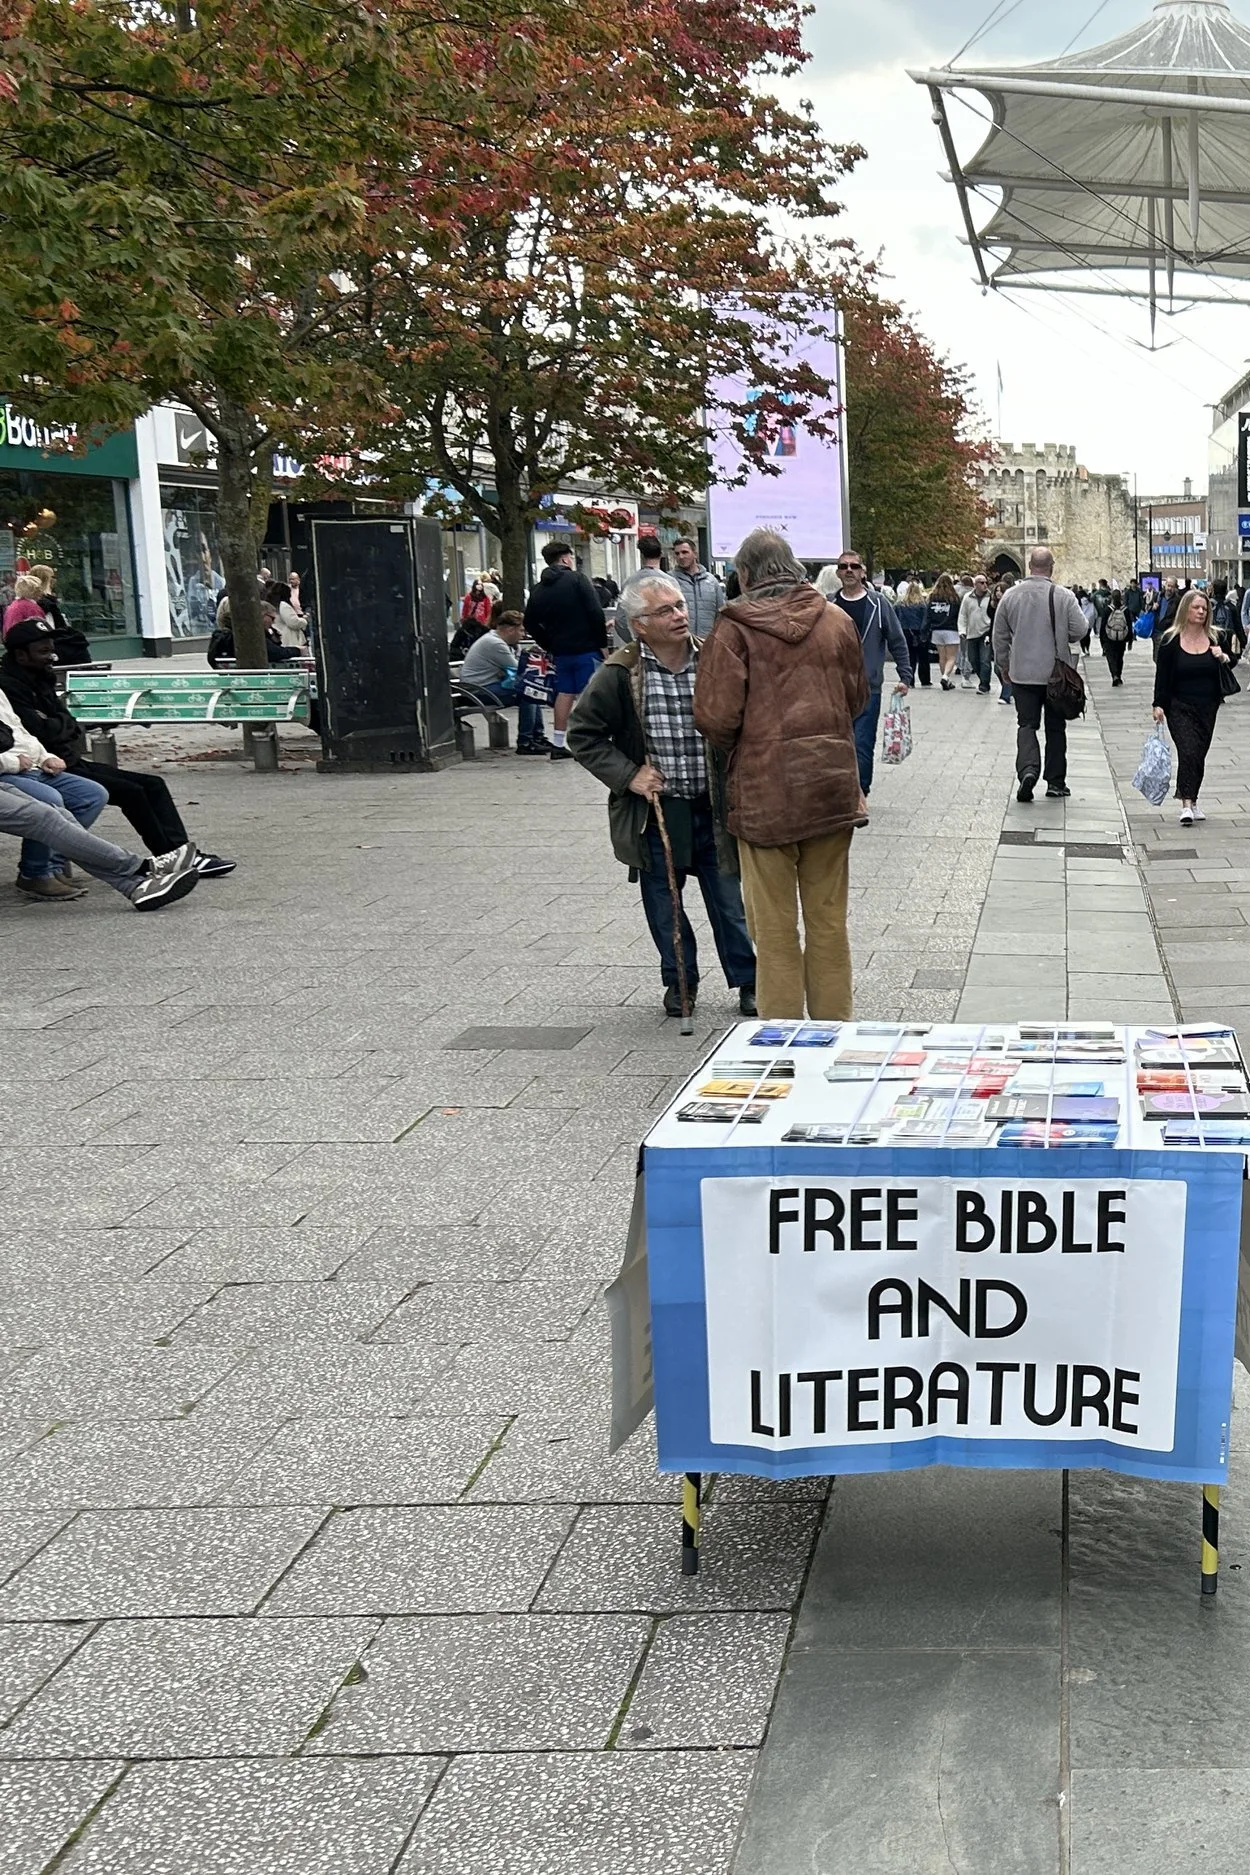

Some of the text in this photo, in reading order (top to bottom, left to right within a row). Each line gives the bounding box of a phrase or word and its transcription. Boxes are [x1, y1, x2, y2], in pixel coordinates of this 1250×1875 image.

[202, 678, 217, 686] ride
[260, 678, 276, 686] ride
[767, 1186, 1127, 1255] FREE BIBLE
[866, 1277, 1029, 1341] AND
[750, 1360, 1141, 1437] LITERATURE
